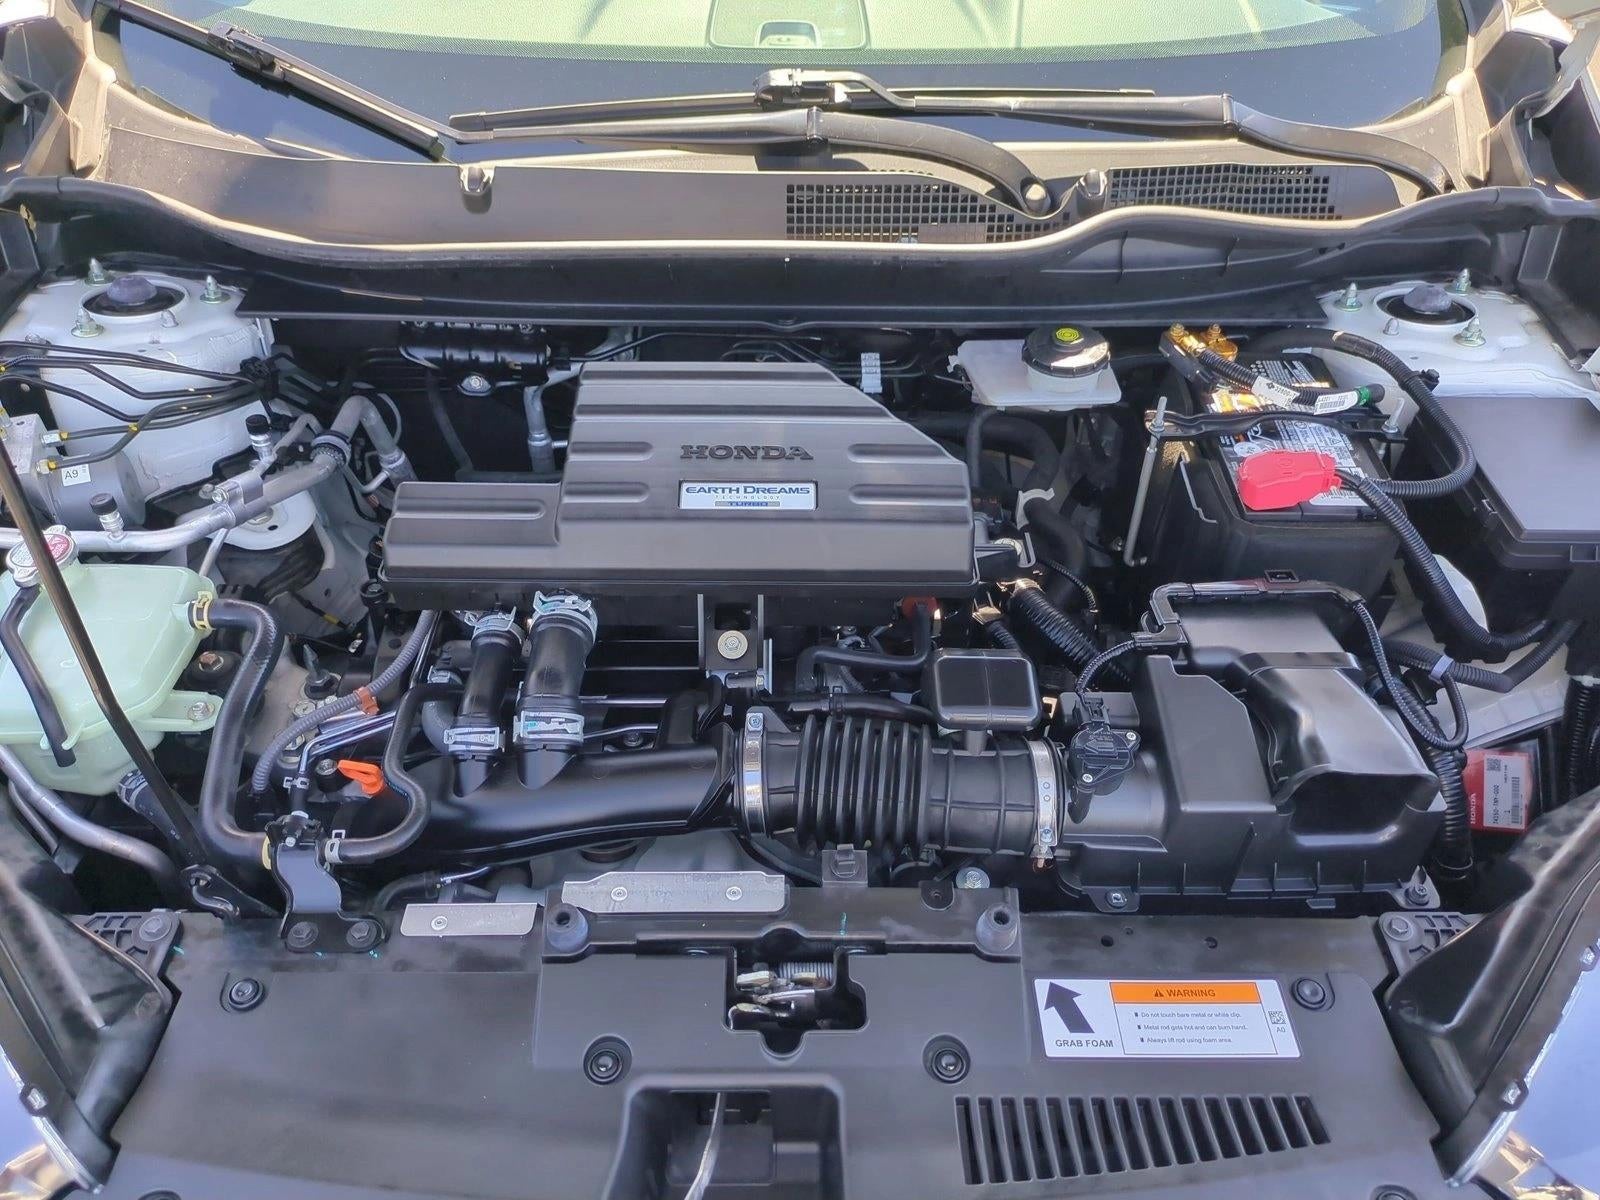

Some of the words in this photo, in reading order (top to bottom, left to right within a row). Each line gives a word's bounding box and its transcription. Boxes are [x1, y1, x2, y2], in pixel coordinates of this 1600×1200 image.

[680, 444, 814, 460] HONDA
[65, 469, 79, 480] A9
[686, 486, 740, 494] EARTH
[743, 485, 810, 495] DREAMS
[1166, 988, 1216, 998] WARNING
